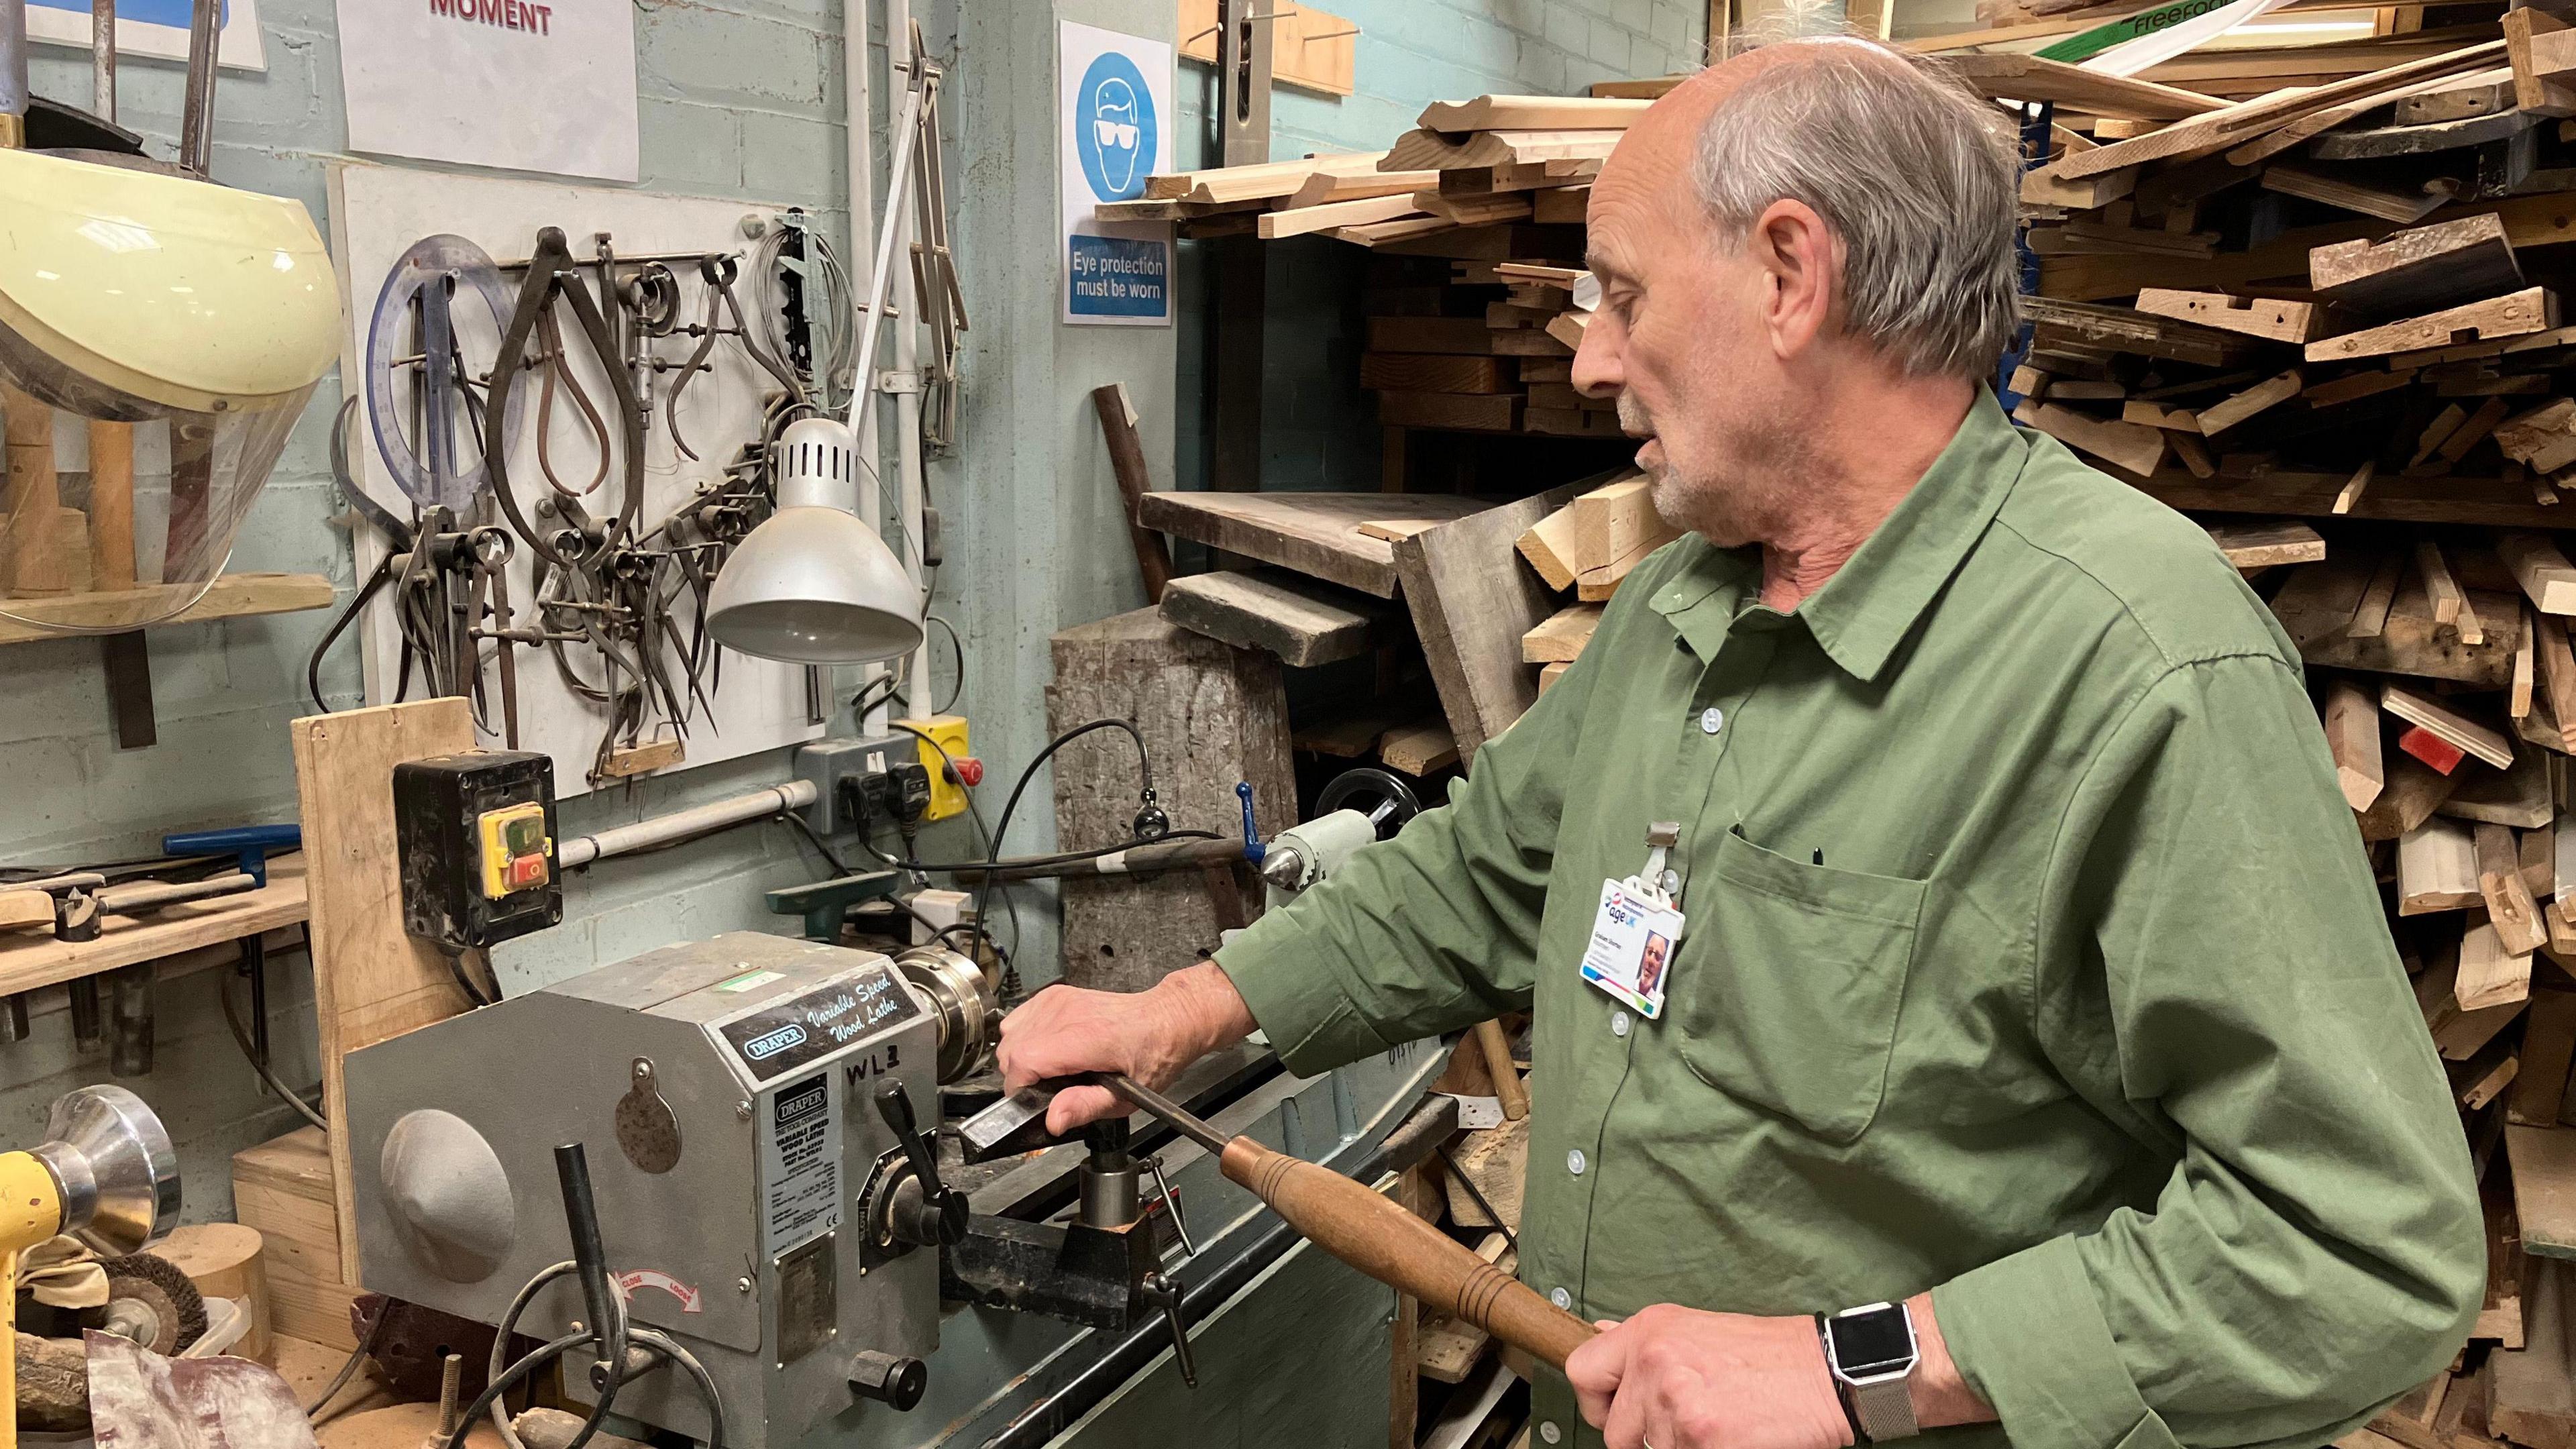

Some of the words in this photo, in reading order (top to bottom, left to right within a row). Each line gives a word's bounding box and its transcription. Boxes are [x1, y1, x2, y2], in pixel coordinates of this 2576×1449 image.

[1073, 251, 1097, 276] Eye
[1100, 256, 1163, 276] protection
[1077, 278, 1108, 297] must
[1111, 278, 1126, 298] be
[1129, 281, 1161, 299] worn
[807, 994, 856, 1028] Variable
[855, 973, 891, 1002] Speed
[830, 1014, 865, 1042] Wood
[867, 998, 898, 1025] Lathe
[750, 1028, 802, 1056] DRAPER
[781, 1092, 822, 1118] DRAPER
[776, 1127, 808, 1147] VARIABLE
[809, 1118, 829, 1133] SPEED
[781, 1138, 804, 1153] WOOD
[805, 1128, 825, 1142] LATHE
[622, 1275, 643, 1288] CLOSE
